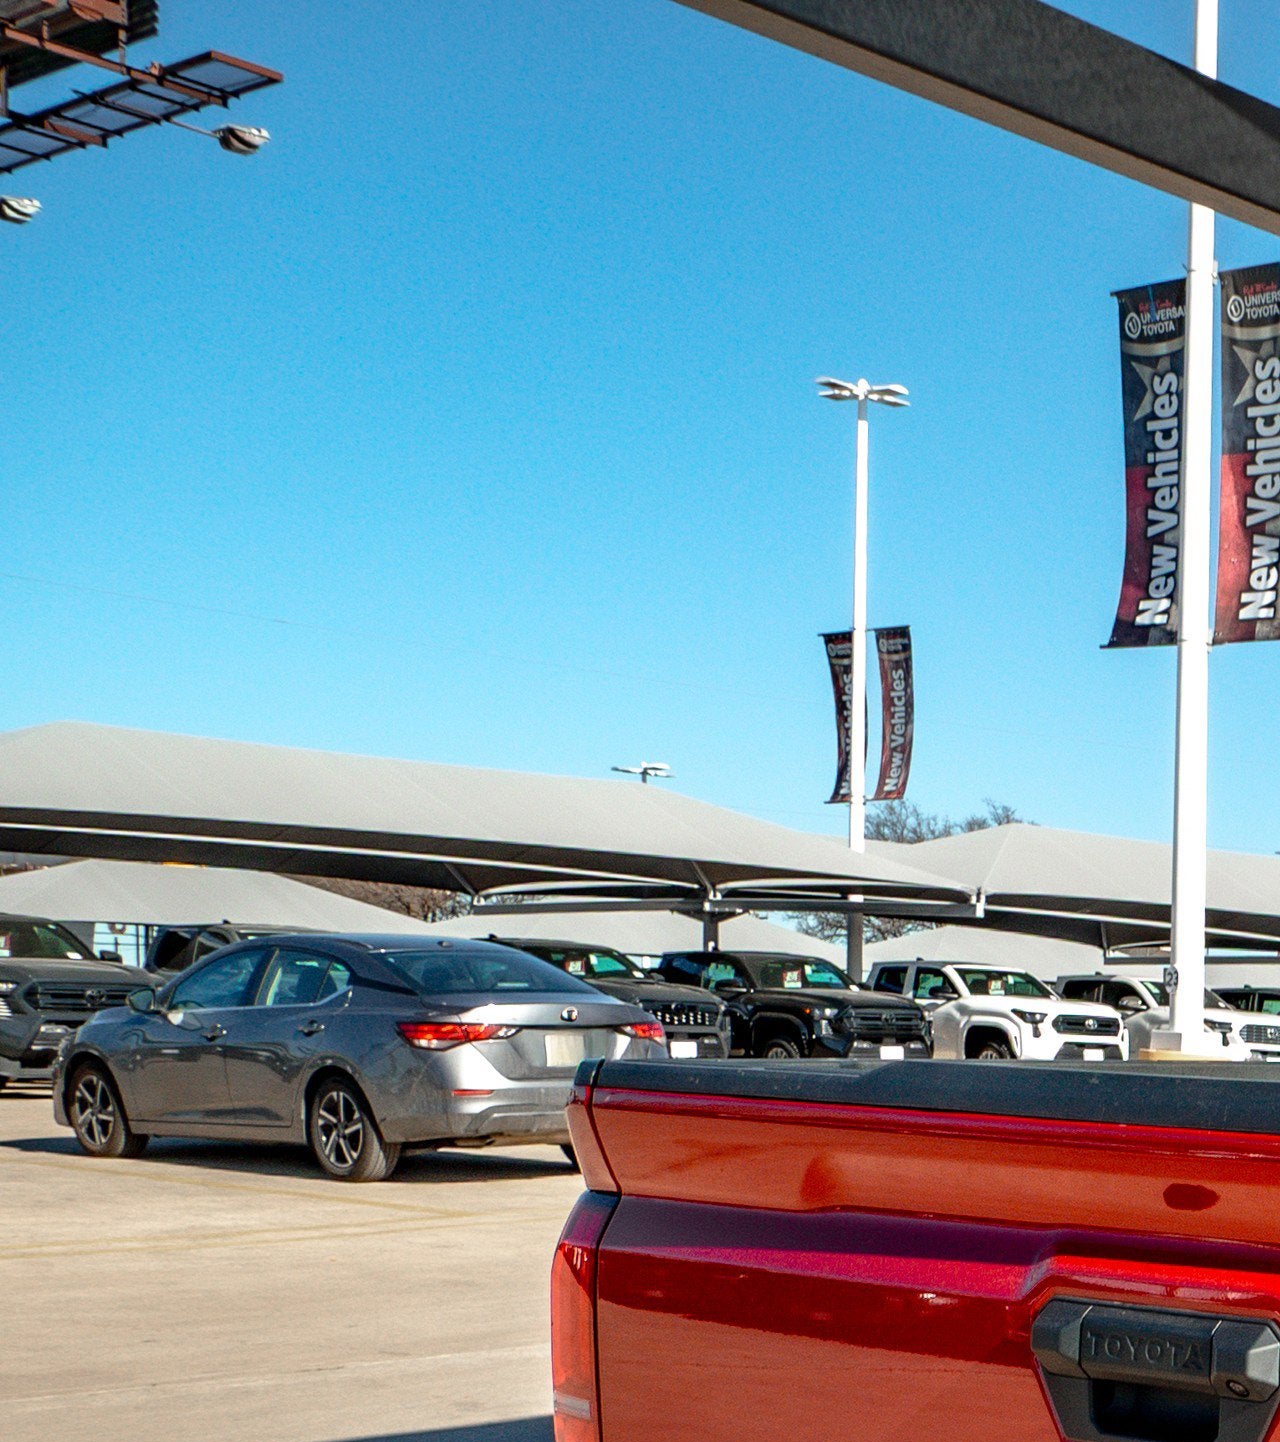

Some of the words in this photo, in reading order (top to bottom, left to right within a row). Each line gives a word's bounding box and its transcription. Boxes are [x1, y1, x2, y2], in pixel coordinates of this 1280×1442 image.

[1142, 320, 1175, 337] TOYOTA
[1246, 304, 1280, 320] TOYOTA
[1147, 371, 1180, 538] Vehicles
[1135, 544, 1177, 626] New
[1238, 533, 1280, 620] New
[890, 669, 906, 748] Vehicles
[884, 751, 904, 792] New
[1086, 1331, 1204, 1371] TOYOTA
